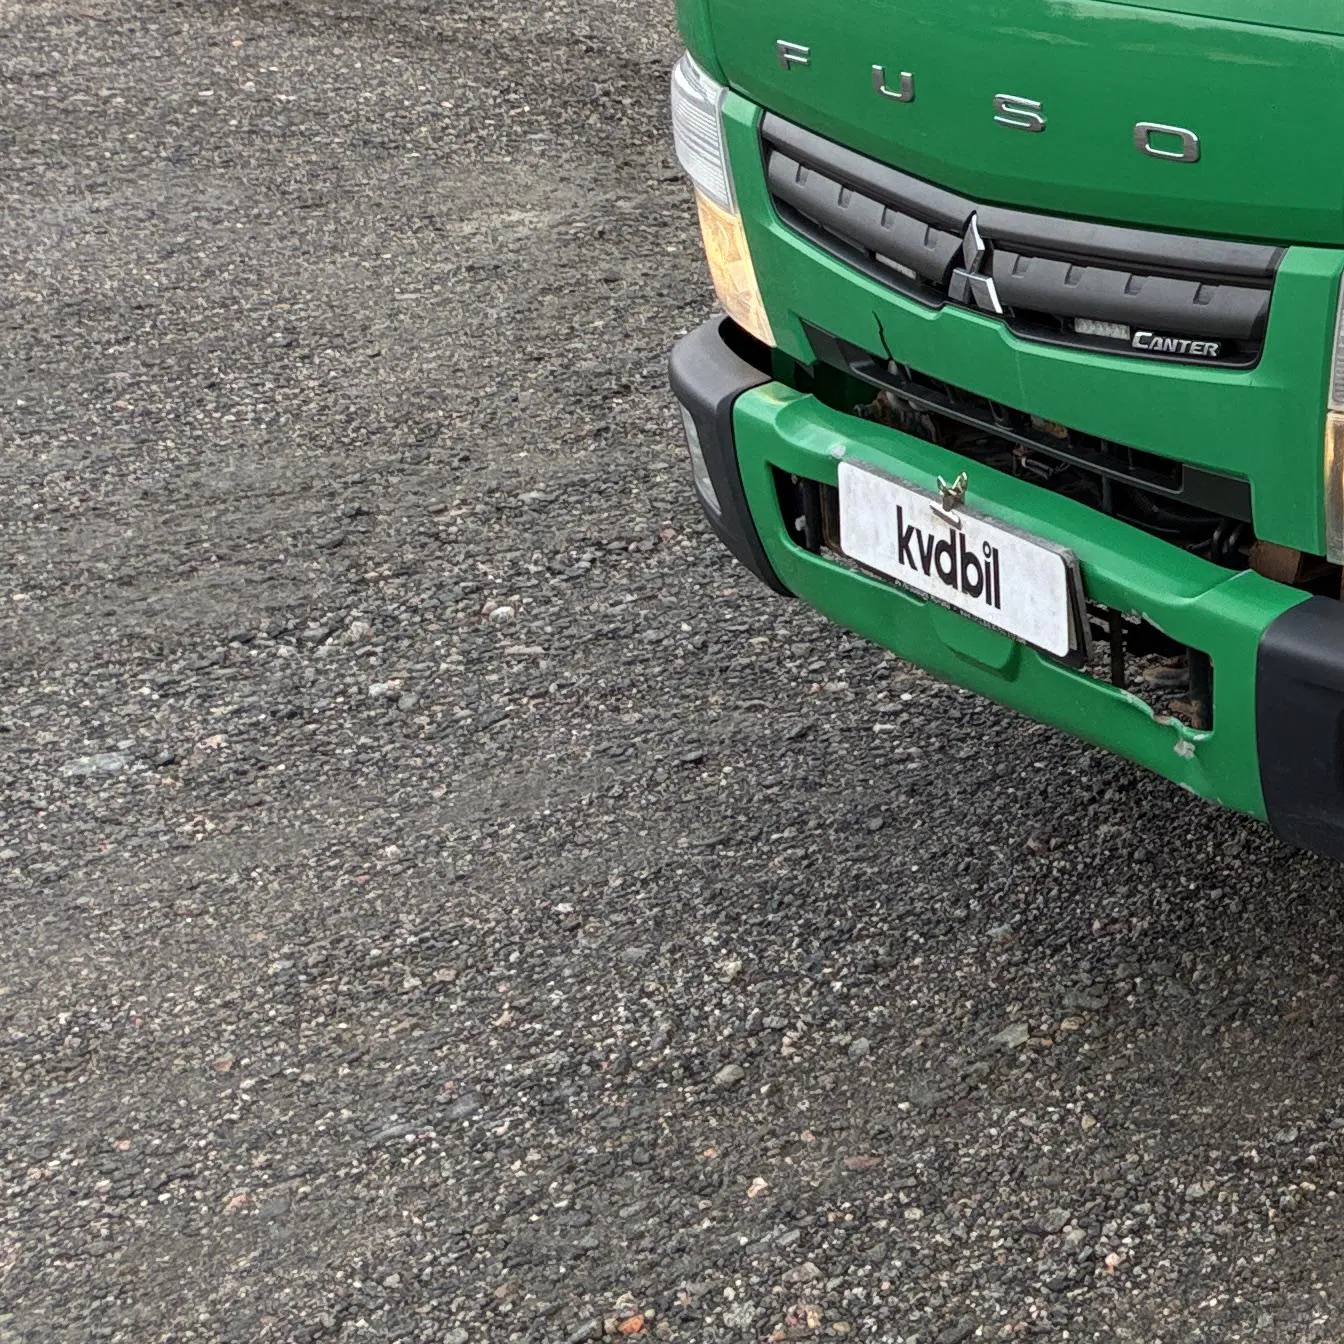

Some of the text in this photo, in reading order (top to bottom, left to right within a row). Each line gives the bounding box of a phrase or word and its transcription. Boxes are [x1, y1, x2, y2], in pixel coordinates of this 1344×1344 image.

[776, 39, 1201, 163] FUSO
[1132, 331, 1220, 356] CANTER
[896, 504, 1001, 610] kvdbil
